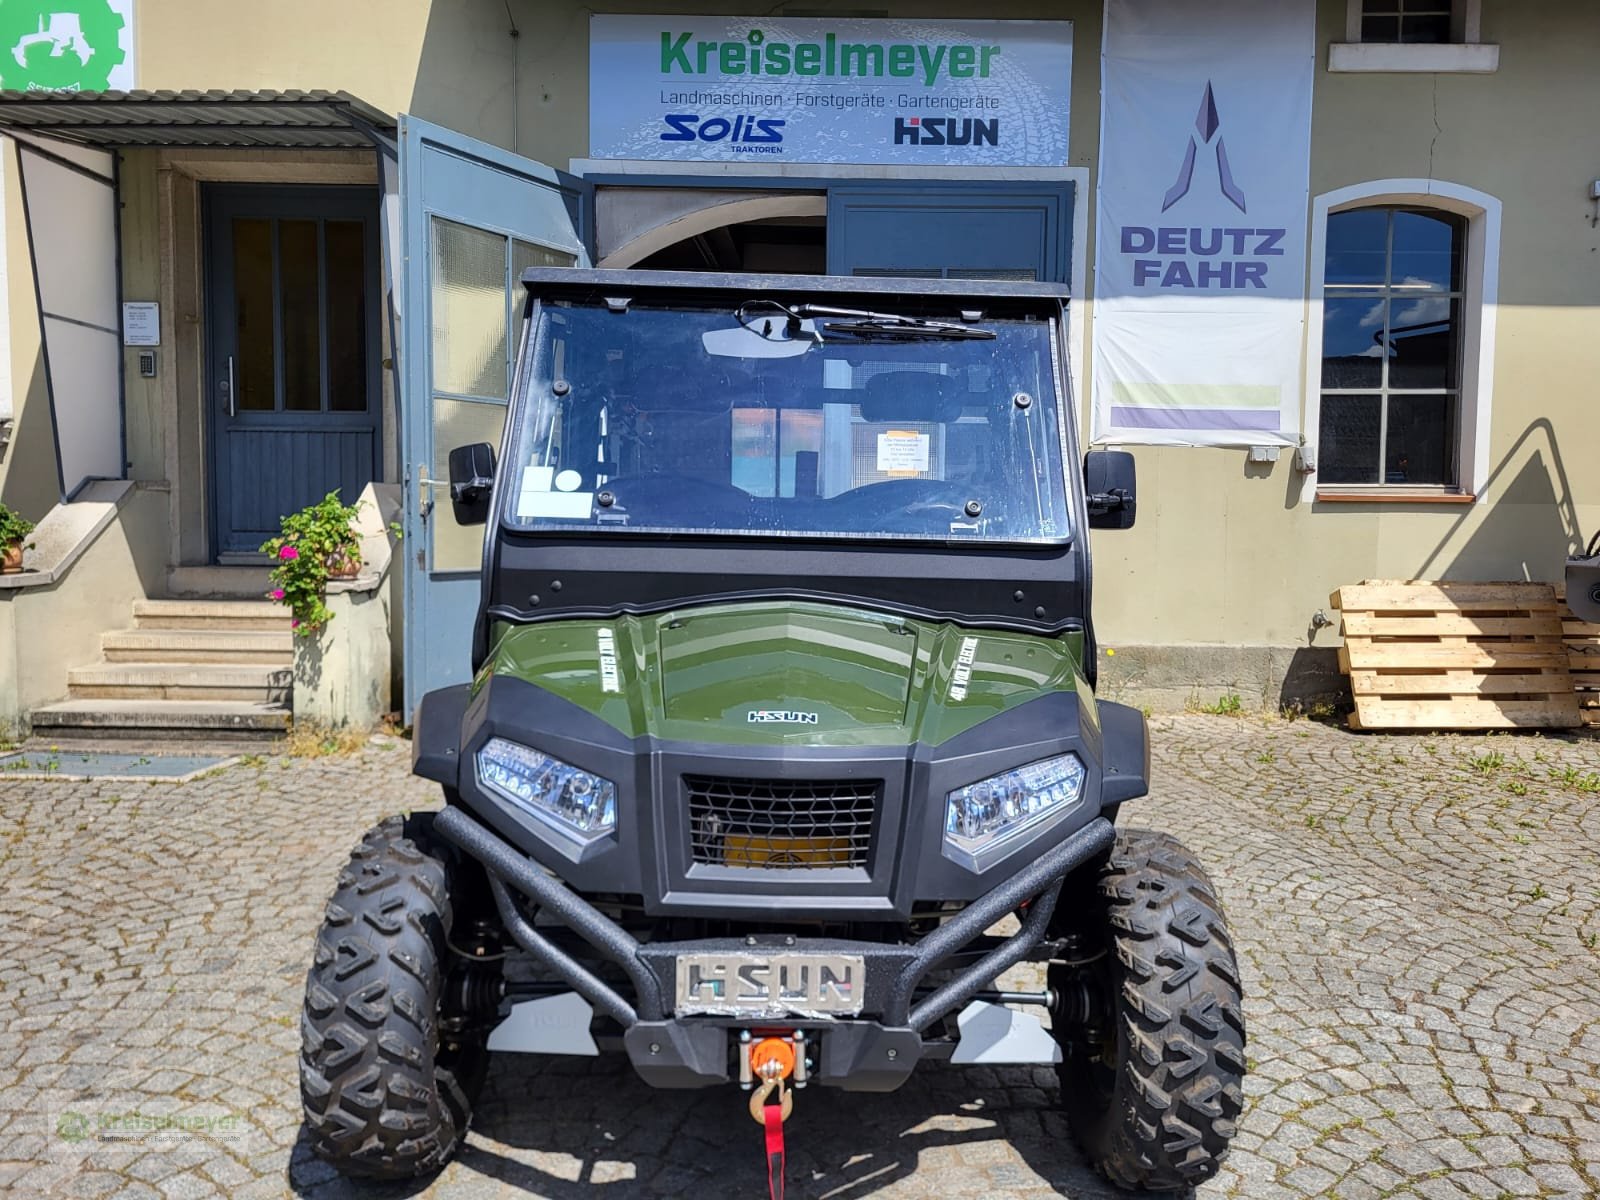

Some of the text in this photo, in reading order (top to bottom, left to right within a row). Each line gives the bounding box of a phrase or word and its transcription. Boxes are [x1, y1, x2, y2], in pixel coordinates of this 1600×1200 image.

[661, 29, 1001, 87] Kreiselmeyer
[660, 90, 1000, 111] Landmaschinen Forstgeräte Gartengeräte
[894, 117, 999, 146] HSUN
[731, 145, 783, 154] TRAKTOREN
[1120, 226, 1286, 256] DEUTZ
[1133, 259, 1268, 289] FAHR
[747, 710, 818, 725] HSUN
[688, 964, 853, 1002] HSUN
